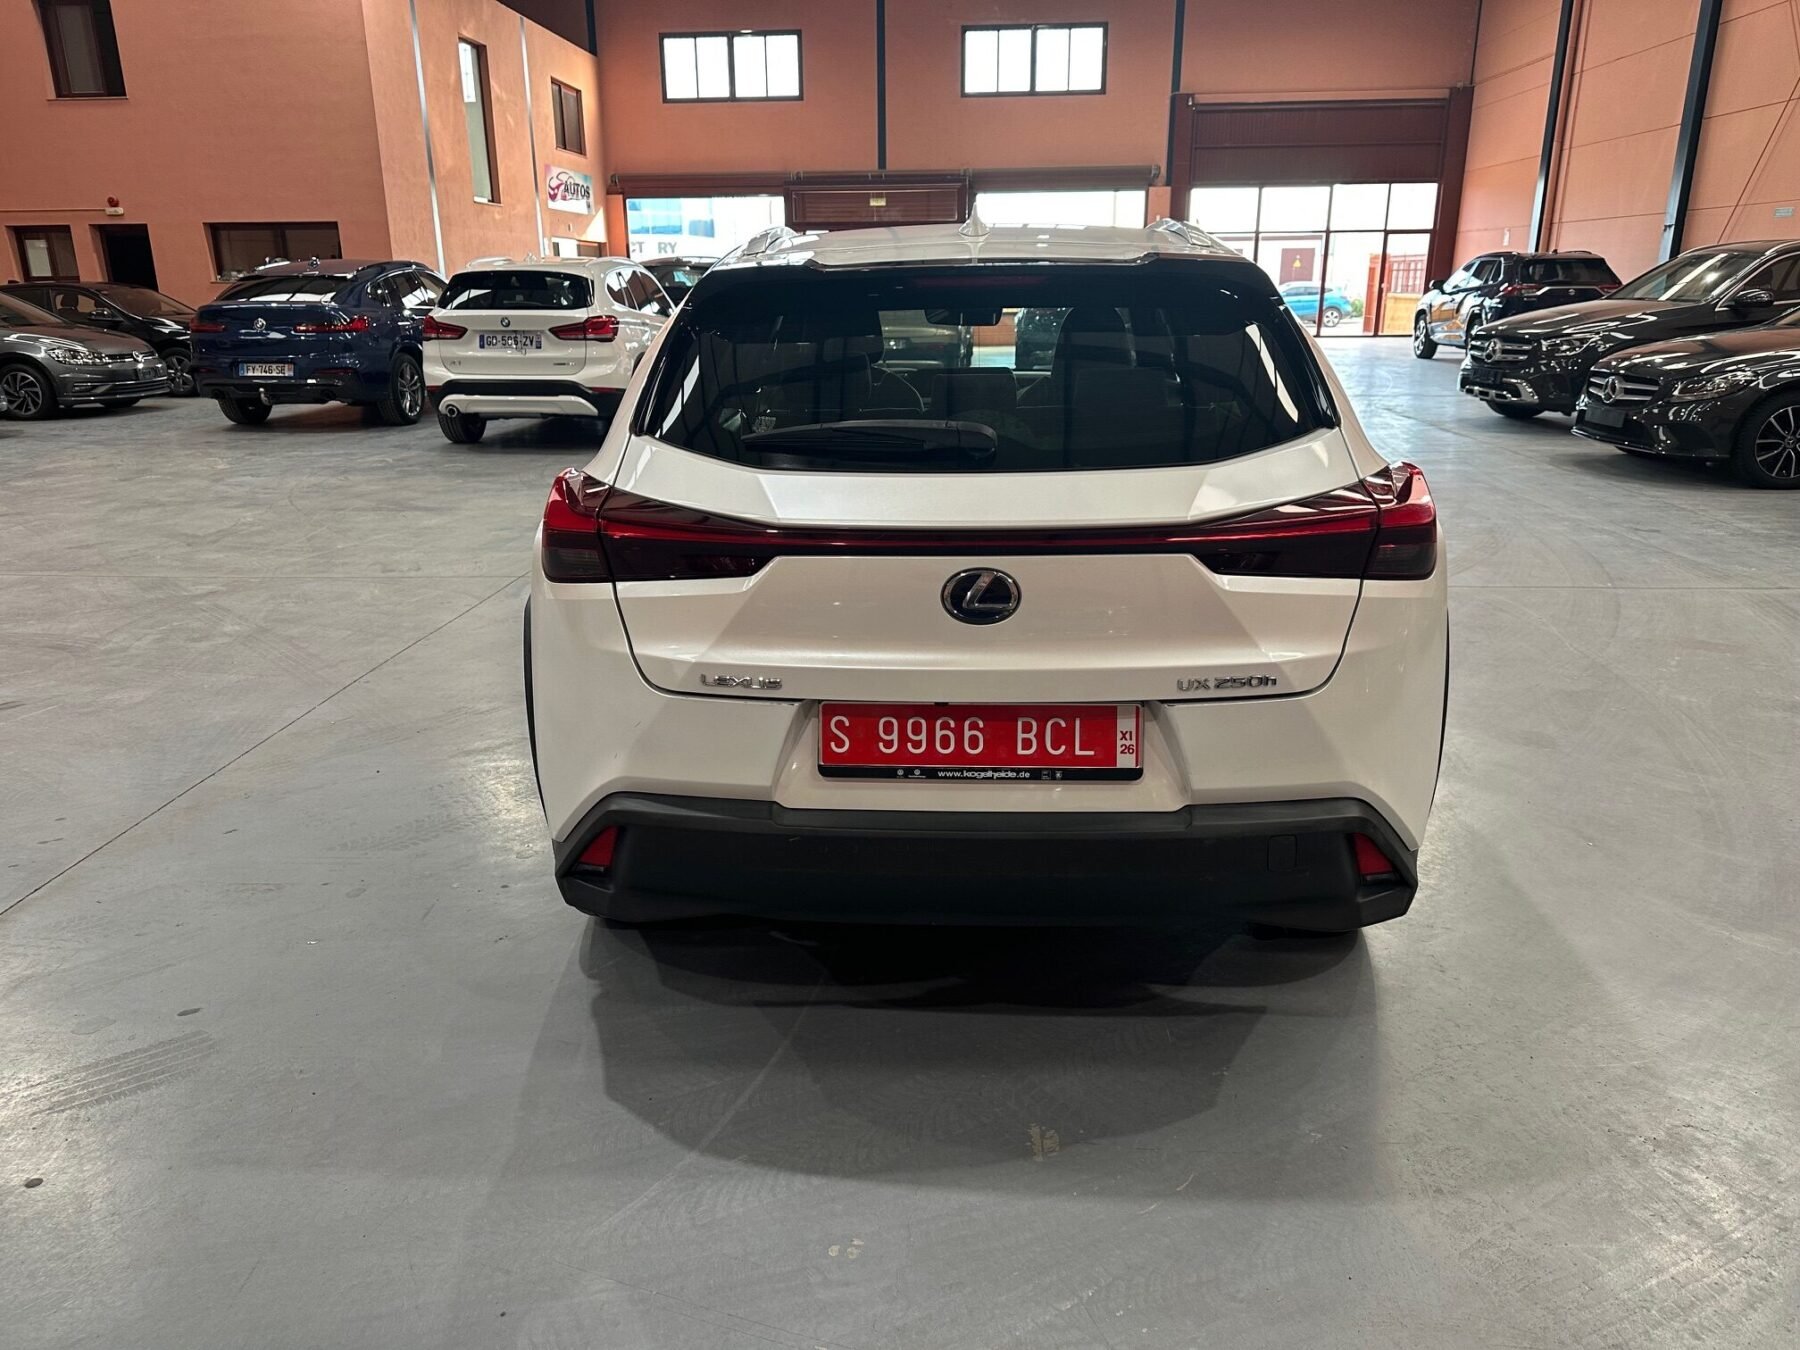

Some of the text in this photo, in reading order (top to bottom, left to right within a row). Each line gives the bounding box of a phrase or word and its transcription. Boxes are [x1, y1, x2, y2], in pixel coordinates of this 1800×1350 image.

[564, 180, 590, 198] AUTOS
[700, 673, 782, 690] LEXUS
[1177, 675, 1277, 692] UX 250h
[830, 715, 1095, 756] S 9966 BCL
[1120, 730, 1133, 741] XI
[1120, 744, 1135, 755] 26
